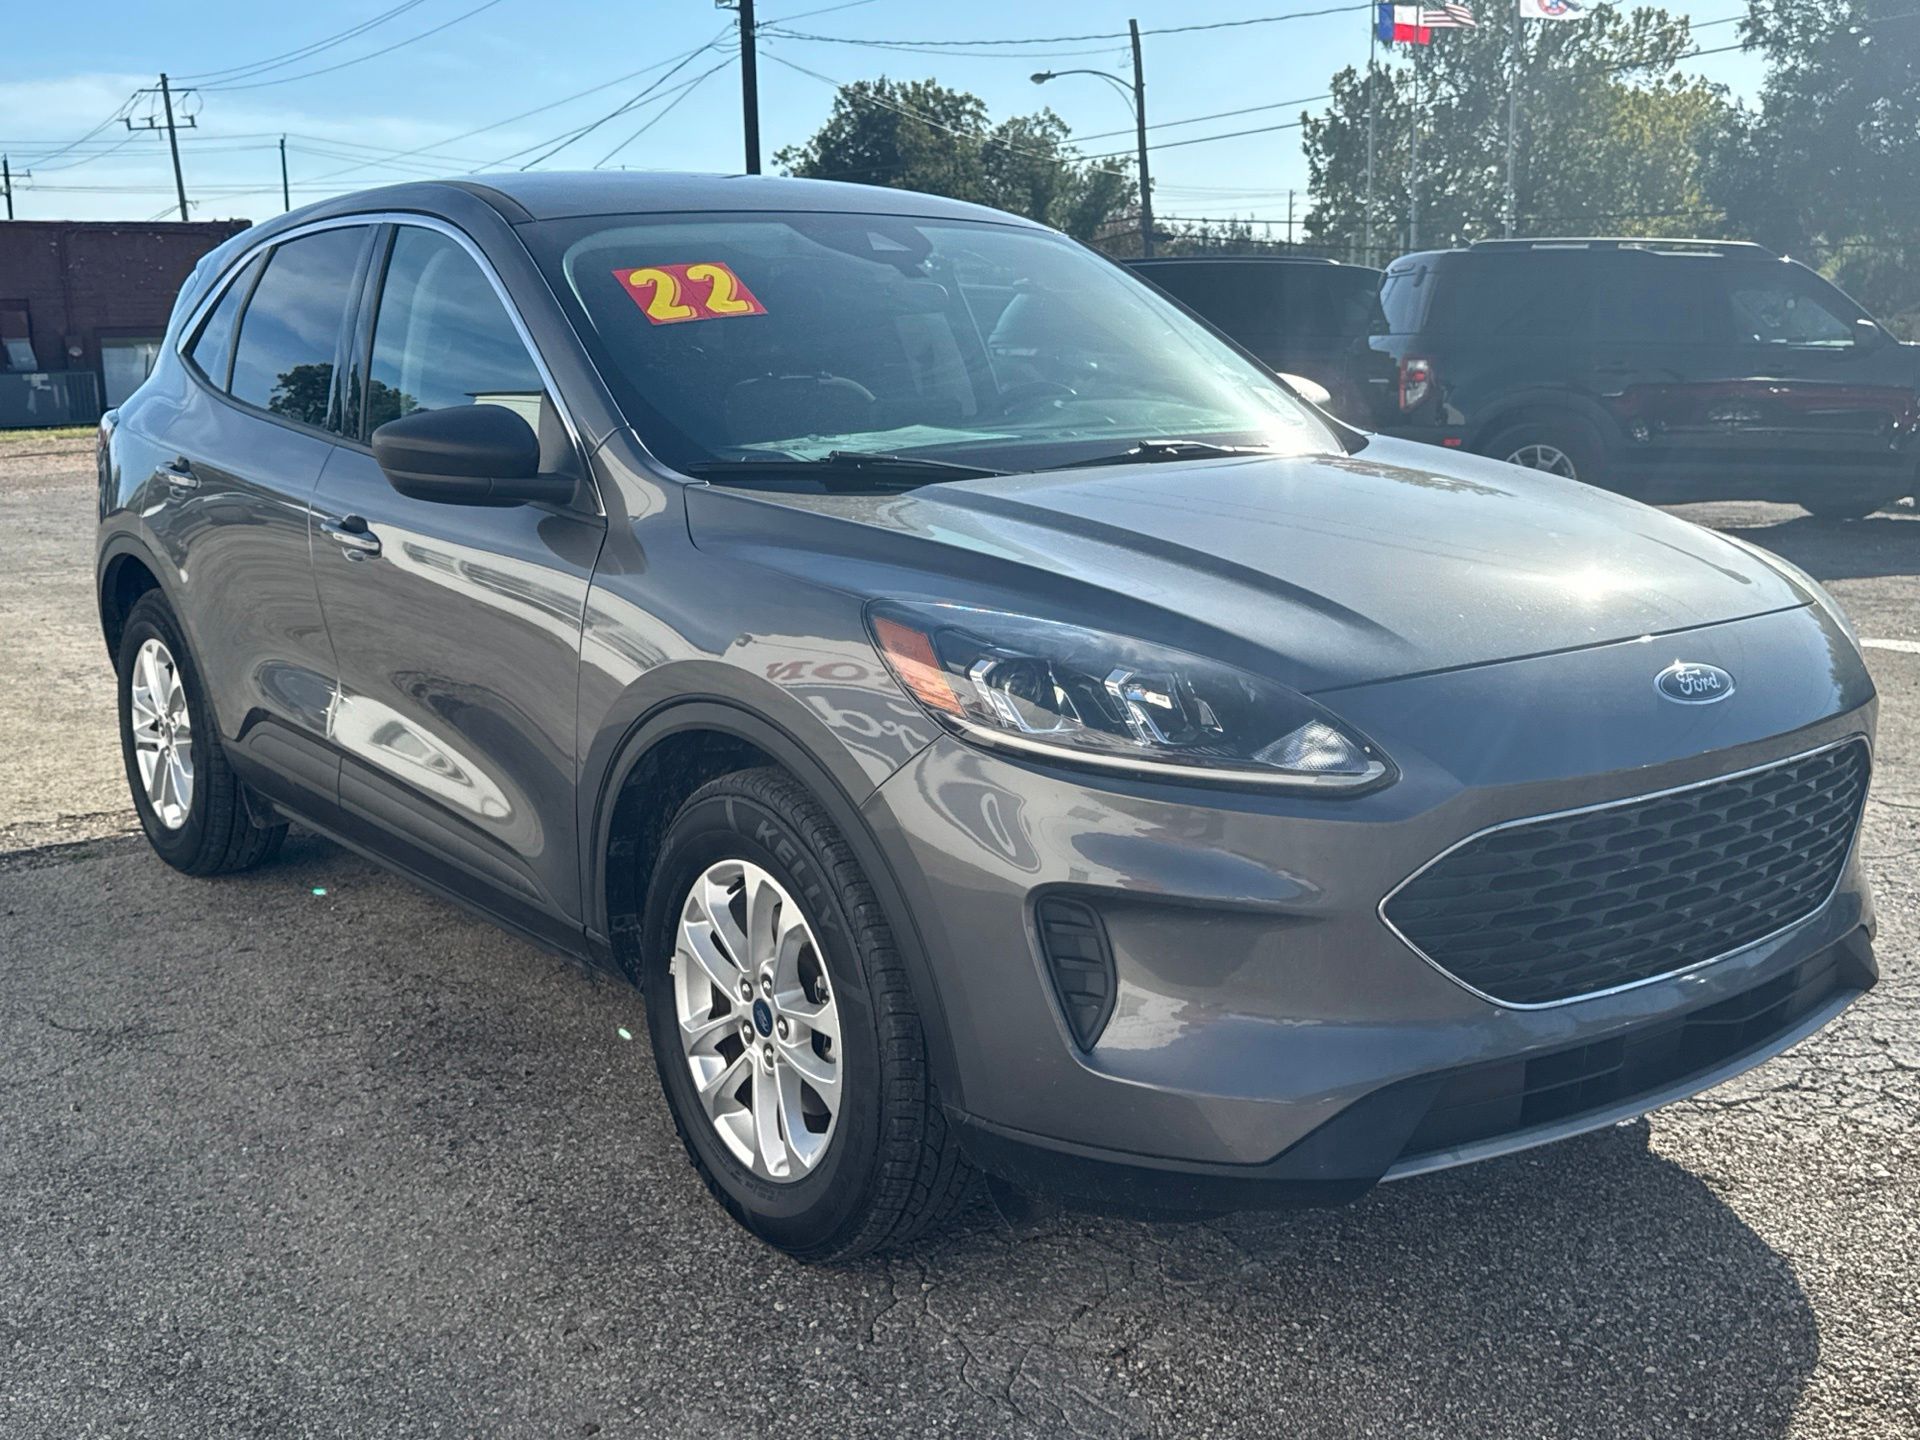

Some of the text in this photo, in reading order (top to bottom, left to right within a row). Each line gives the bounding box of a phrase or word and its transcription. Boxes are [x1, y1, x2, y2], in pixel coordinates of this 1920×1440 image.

[629, 264, 754, 321] 22
[1676, 669, 1720, 695] Ford
[755, 820, 838, 931] KELLY
